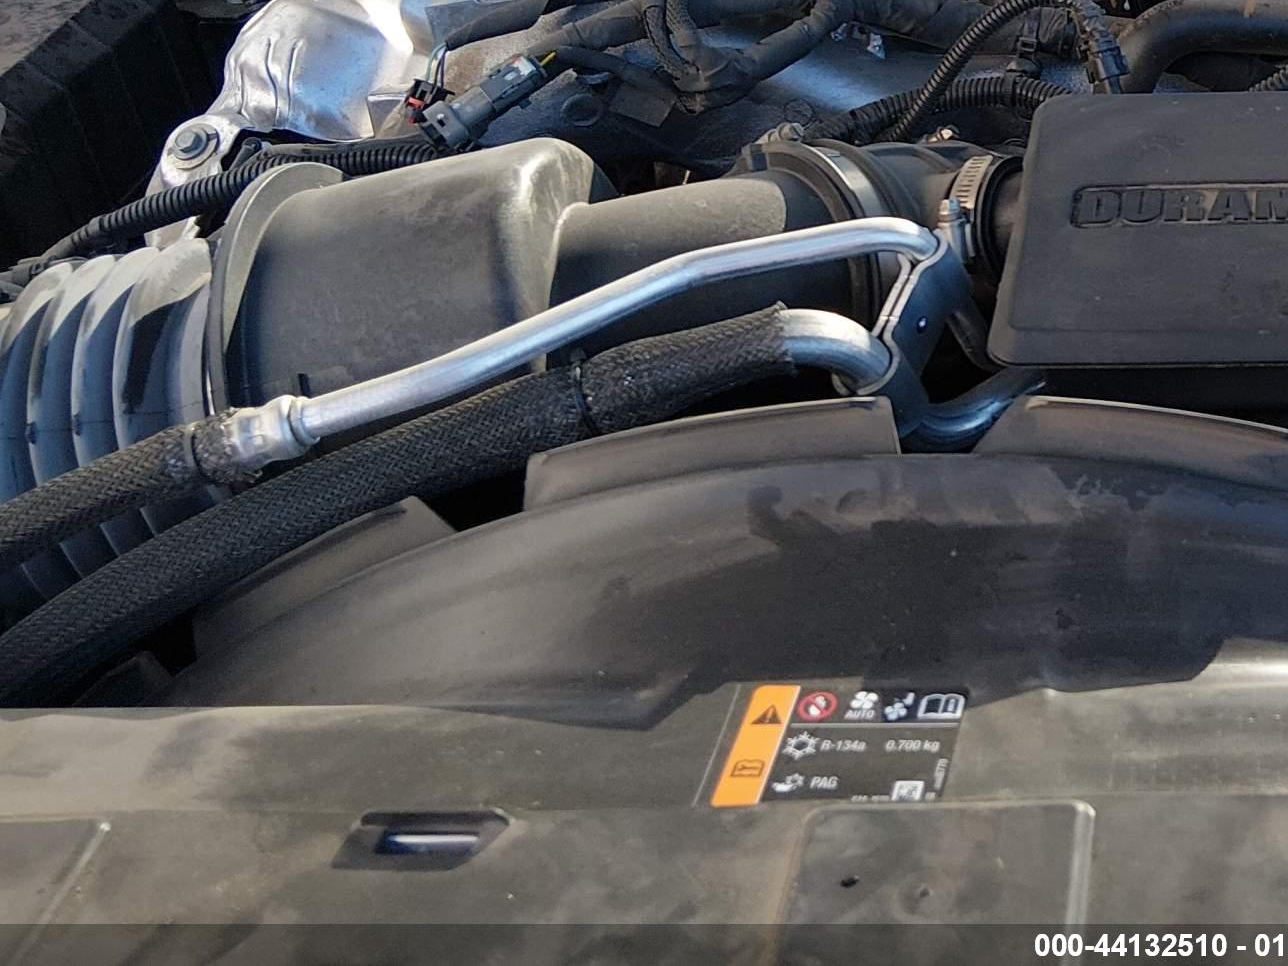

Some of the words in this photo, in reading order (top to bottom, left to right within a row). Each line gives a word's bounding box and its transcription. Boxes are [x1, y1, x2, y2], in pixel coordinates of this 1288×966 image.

[845, 709, 875, 719] AUTO
[821, 740, 866, 751] R-134a
[885, 739, 921, 752] 0.700
[922, 739, 941, 753] kg
[810, 776, 838, 789] PAG
